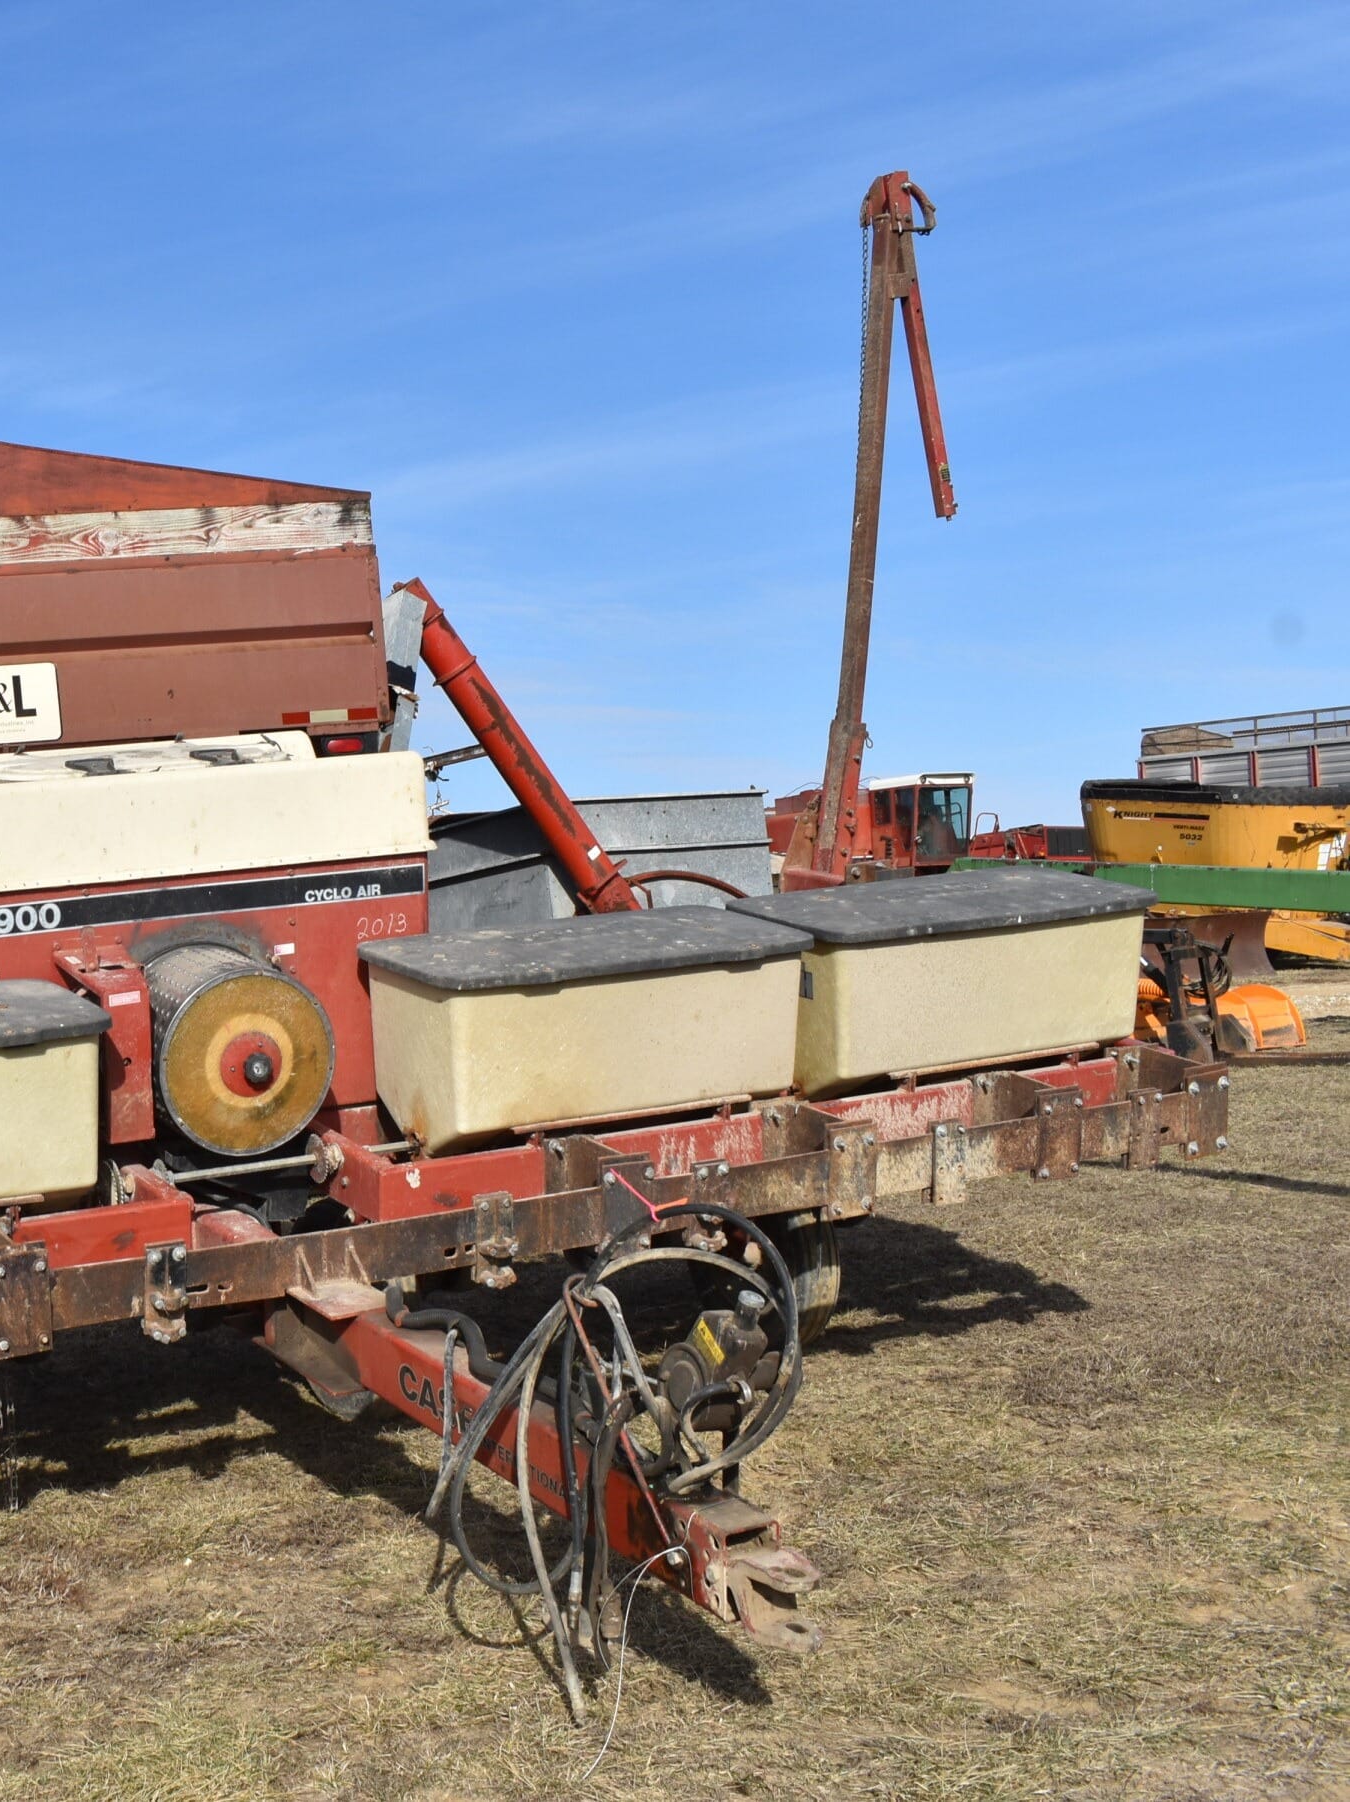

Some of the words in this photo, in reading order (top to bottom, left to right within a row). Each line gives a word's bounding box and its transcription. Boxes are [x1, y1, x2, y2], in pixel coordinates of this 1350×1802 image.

[1114, 811, 1153, 819] KNIGHT
[305, 886, 352, 903] CYCLO
[356, 883, 382, 898] AIR
[356, 913, 407, 940] 2013
